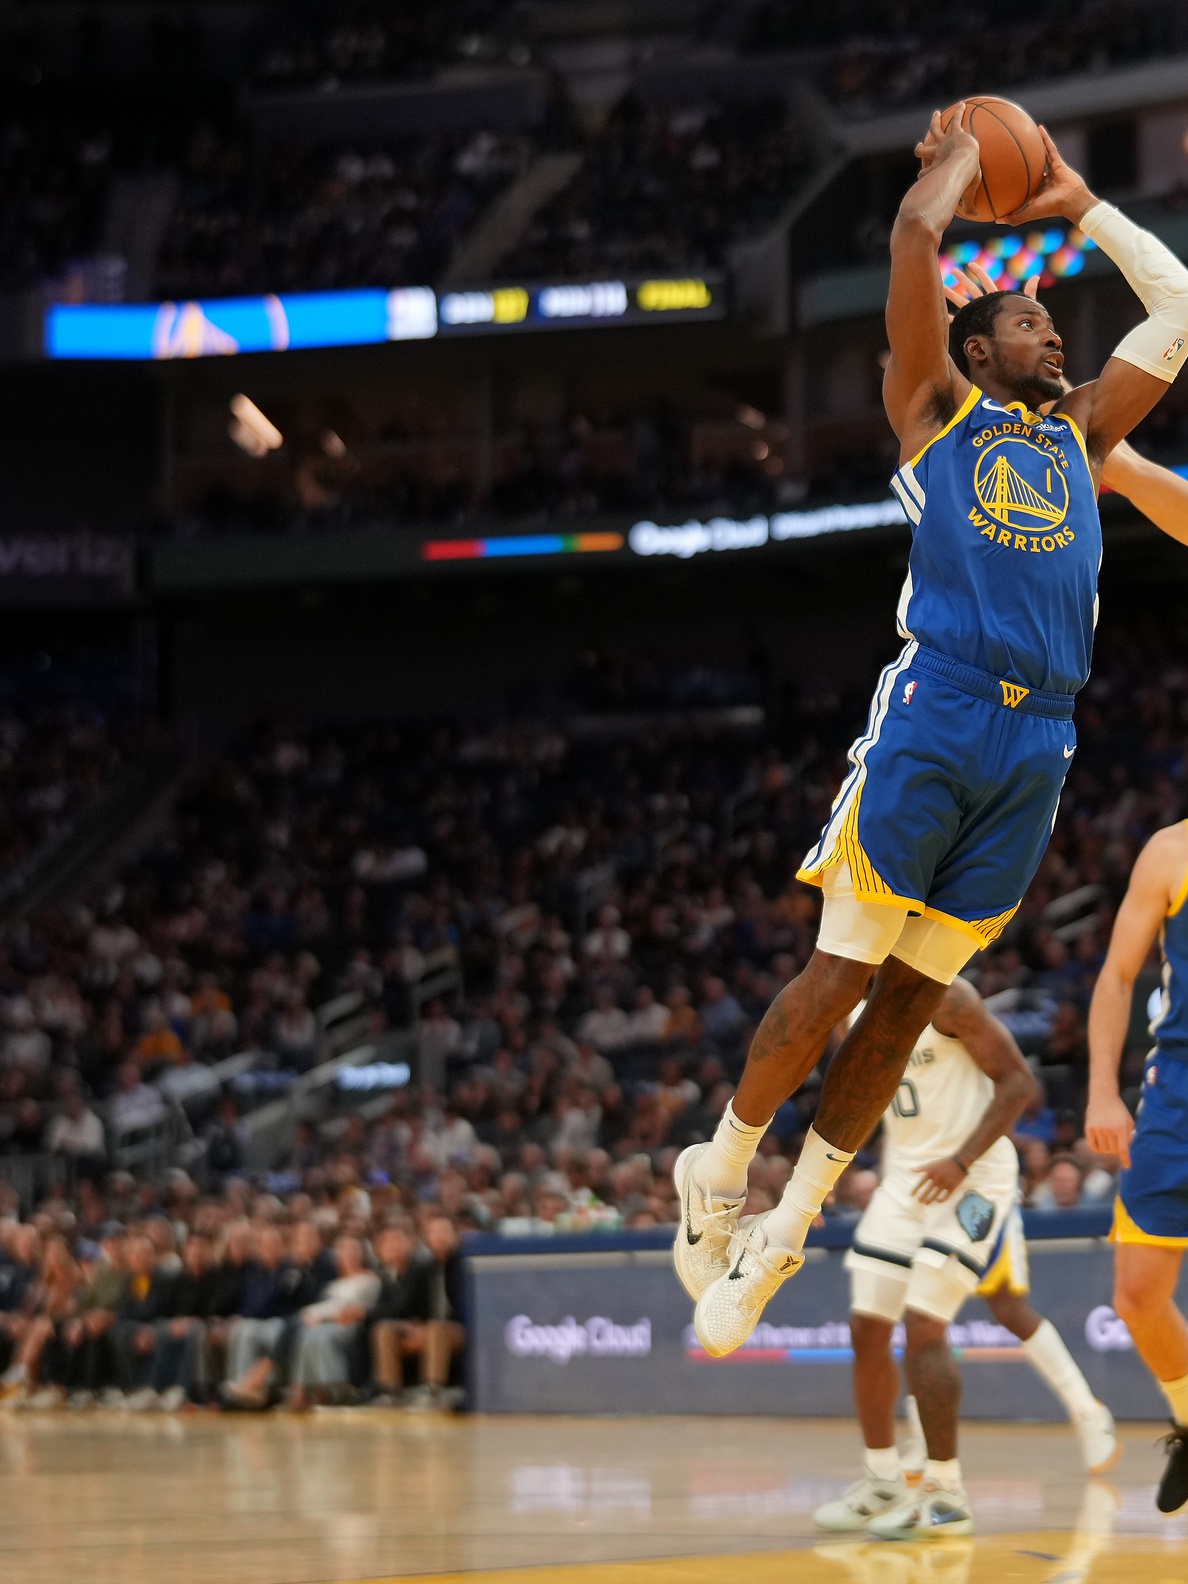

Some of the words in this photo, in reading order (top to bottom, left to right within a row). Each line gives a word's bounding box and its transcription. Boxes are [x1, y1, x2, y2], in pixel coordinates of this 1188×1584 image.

[972, 423, 1033, 448] GOLDEN
[1035, 433, 1068, 470] STATE
[1046, 468, 1052, 493] 1
[967, 506, 1075, 553] WARRIORS
[504, 1314, 588, 1365] Google
[587, 1316, 651, 1356] Cloud
